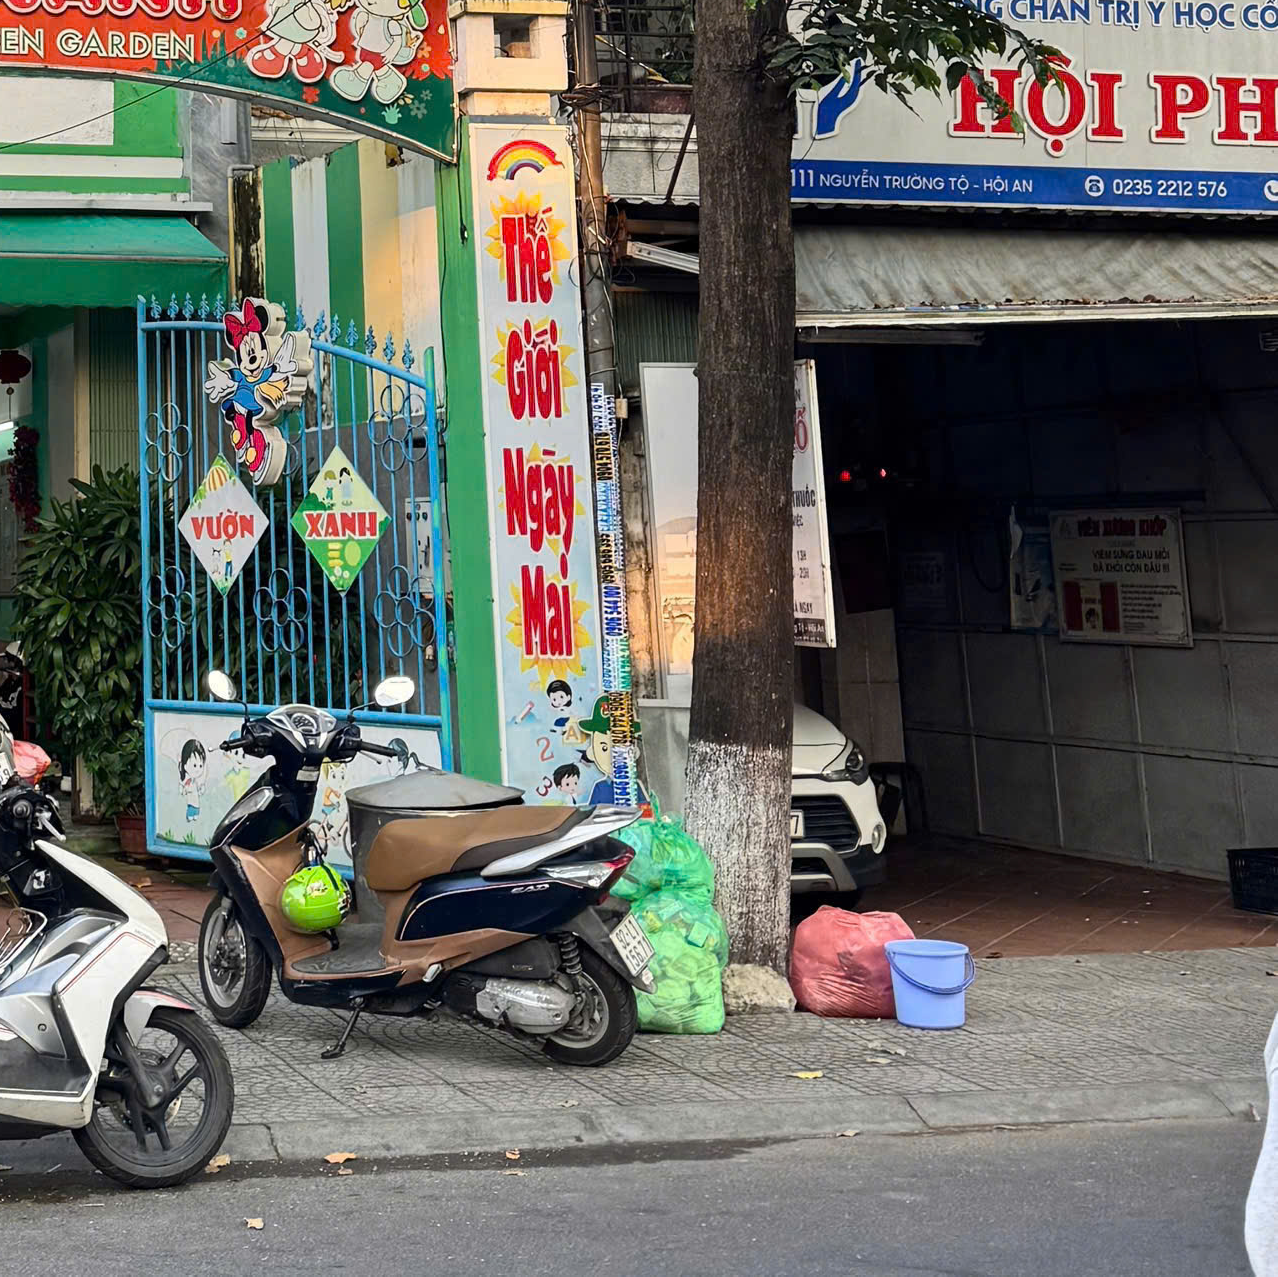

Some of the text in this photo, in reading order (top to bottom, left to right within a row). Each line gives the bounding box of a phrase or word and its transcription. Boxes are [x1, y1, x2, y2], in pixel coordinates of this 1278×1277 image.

[1147, 0, 1166, 25] Y
[1174, 1, 1236, 31] HỌC
[55, 30, 196, 64] GARDEN
[951, 53, 1124, 153] HỘI
[819, 168, 880, 188] NGUYỄN
[883, 172, 945, 190] TRƯỜNG
[949, 174, 970, 194] TỘ
[983, 175, 1009, 195] HỘI
[1012, 179, 1033, 193] AN
[1112, 178, 1228, 198] 0235 2212 576
[499, 205, 554, 304] Thế
[506, 317, 563, 421] Giới
[502, 447, 575, 554] Ngày
[190, 508, 254, 541] VƯỜN
[304, 510, 379, 541] XANH
[521, 552, 573, 658] Mai
[536, 736, 555, 762] 2
